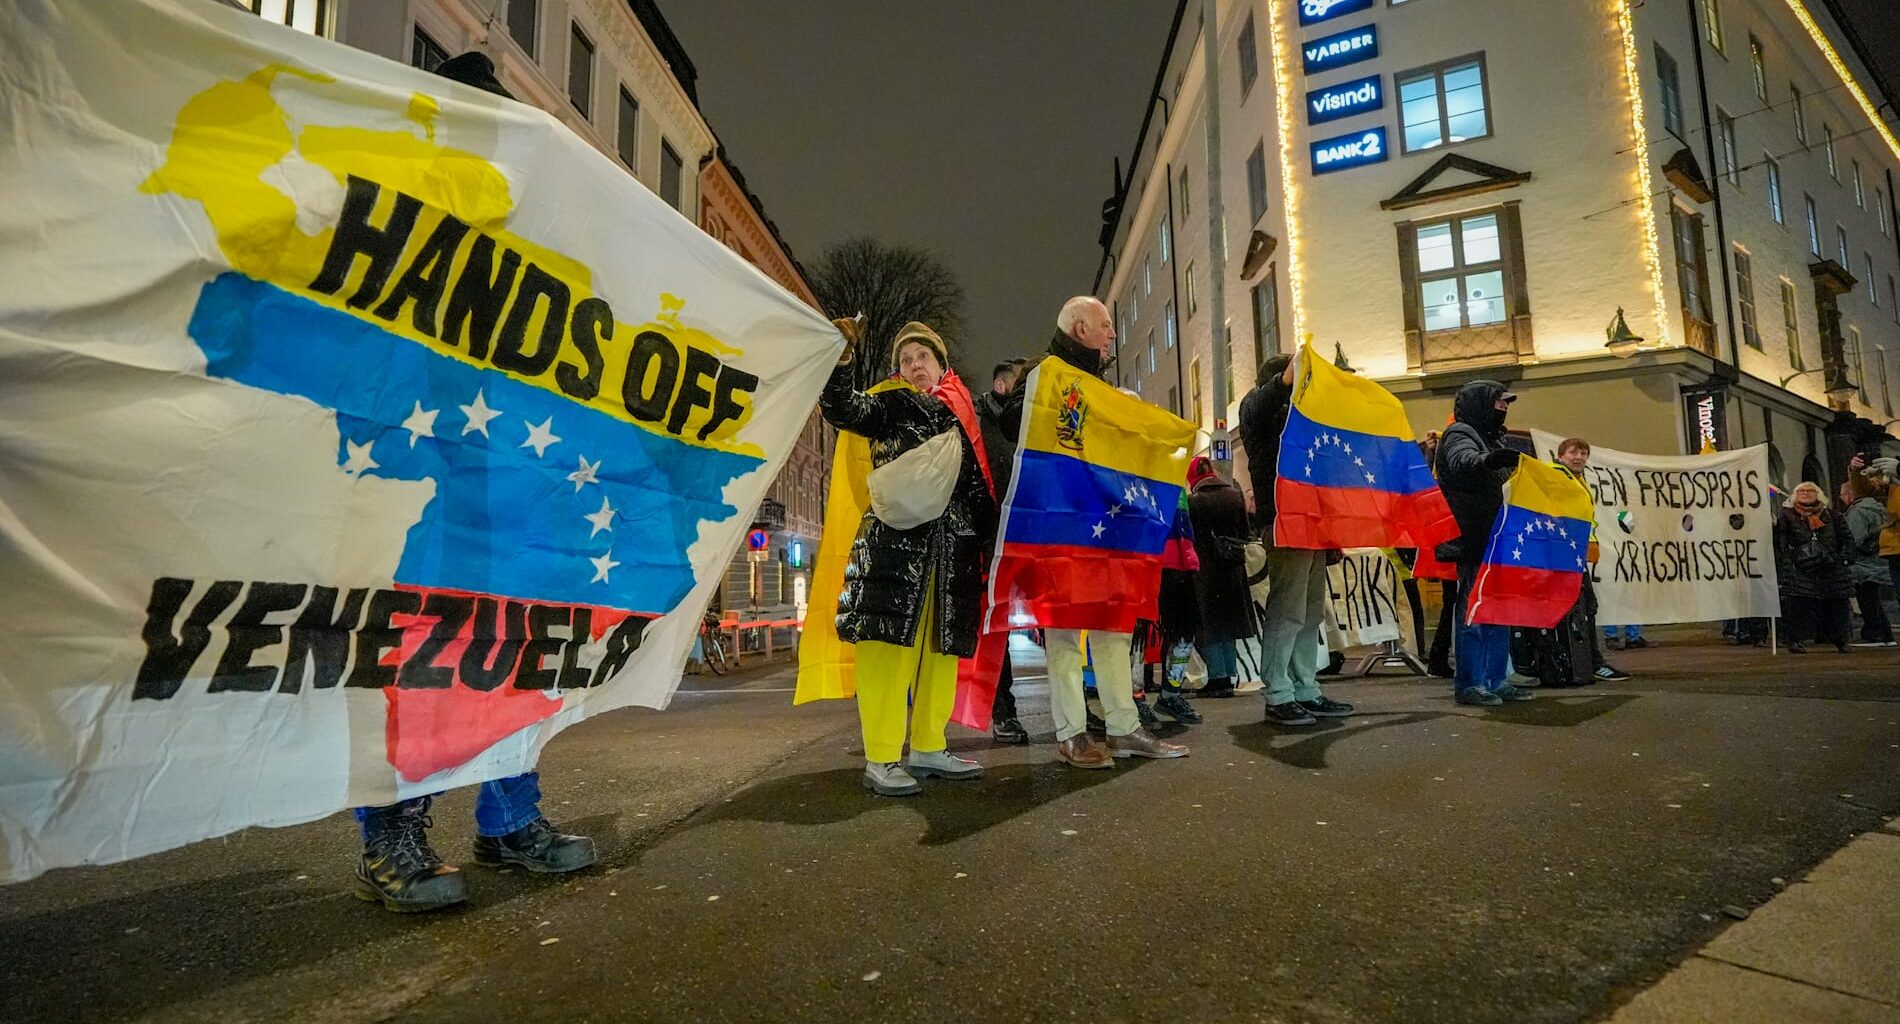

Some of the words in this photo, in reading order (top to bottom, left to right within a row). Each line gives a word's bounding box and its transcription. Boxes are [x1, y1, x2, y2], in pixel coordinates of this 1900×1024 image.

[1306, 34, 1373, 62] VARDER
[1316, 133, 1381, 164] BANK2
[308, 174, 615, 400] HANDS
[621, 330, 759, 441] OFF
[1634, 469, 1762, 509] FREDSPRIS
[1613, 538, 1763, 584] KRIGSHISSERE
[131, 576, 657, 701] VENEZUELA
